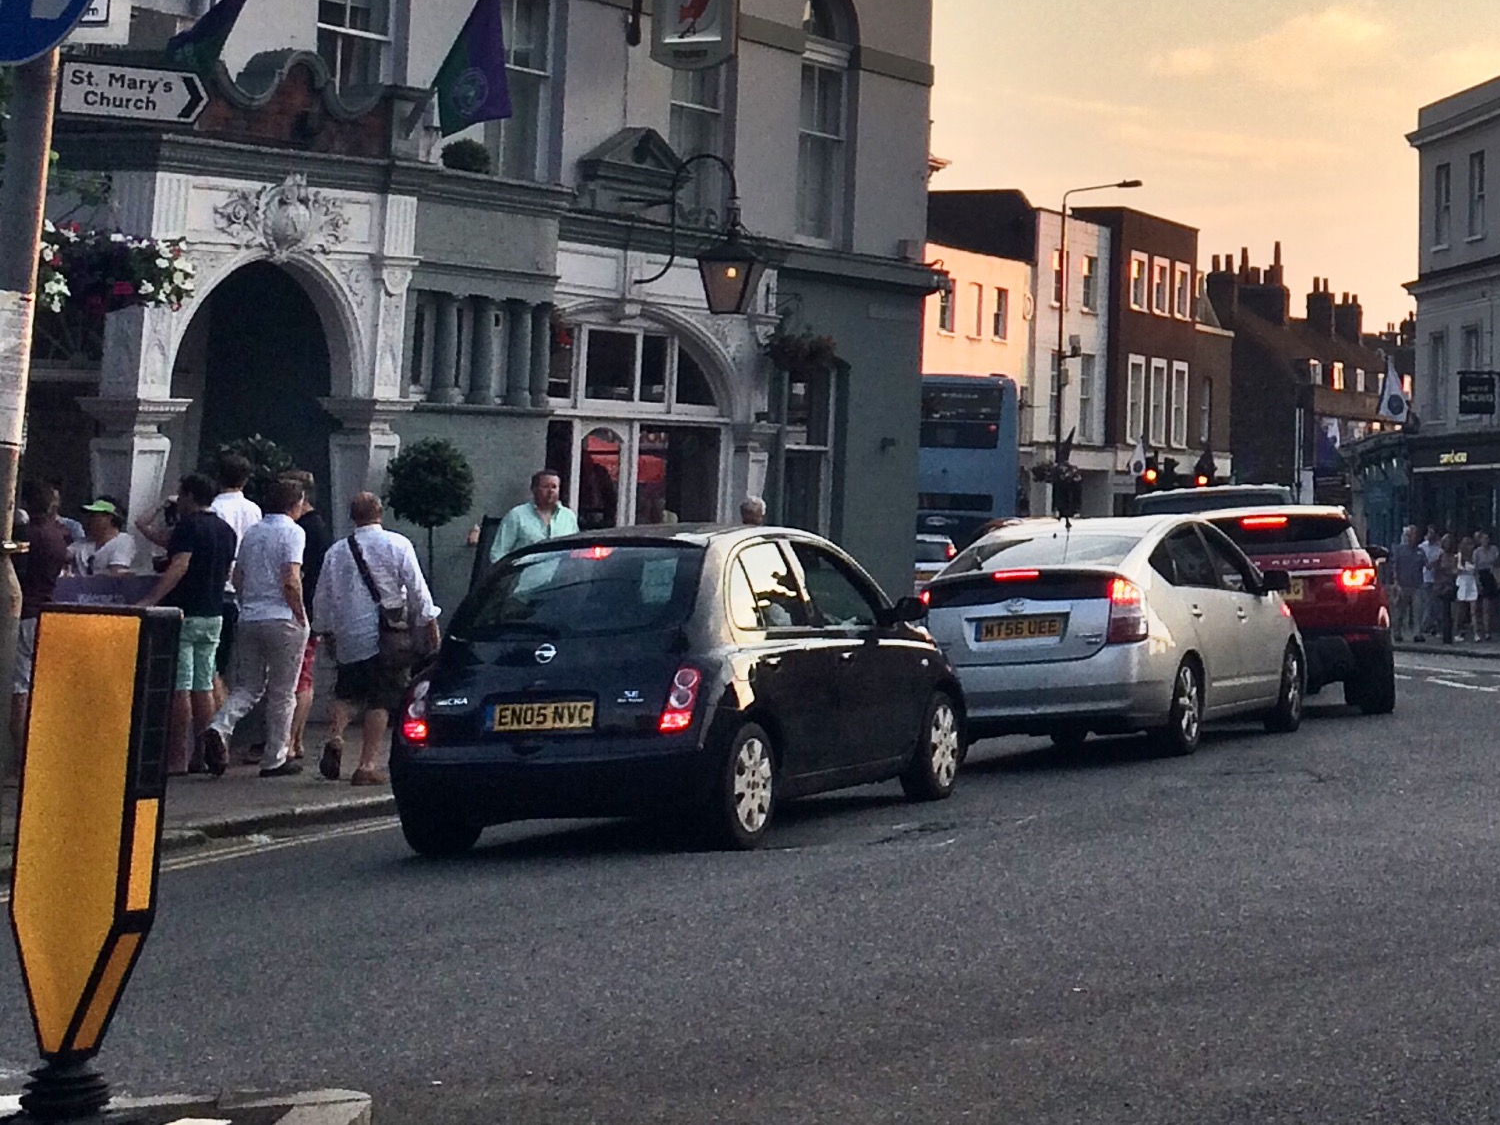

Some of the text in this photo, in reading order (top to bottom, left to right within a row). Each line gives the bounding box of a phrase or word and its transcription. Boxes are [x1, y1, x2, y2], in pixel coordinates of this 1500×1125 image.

[70, 69, 173, 94] St. Mary's
[83, 90, 157, 111] Church
[1028, 619, 1058, 635] UEE
[499, 704, 592, 726] EN05 NVC
